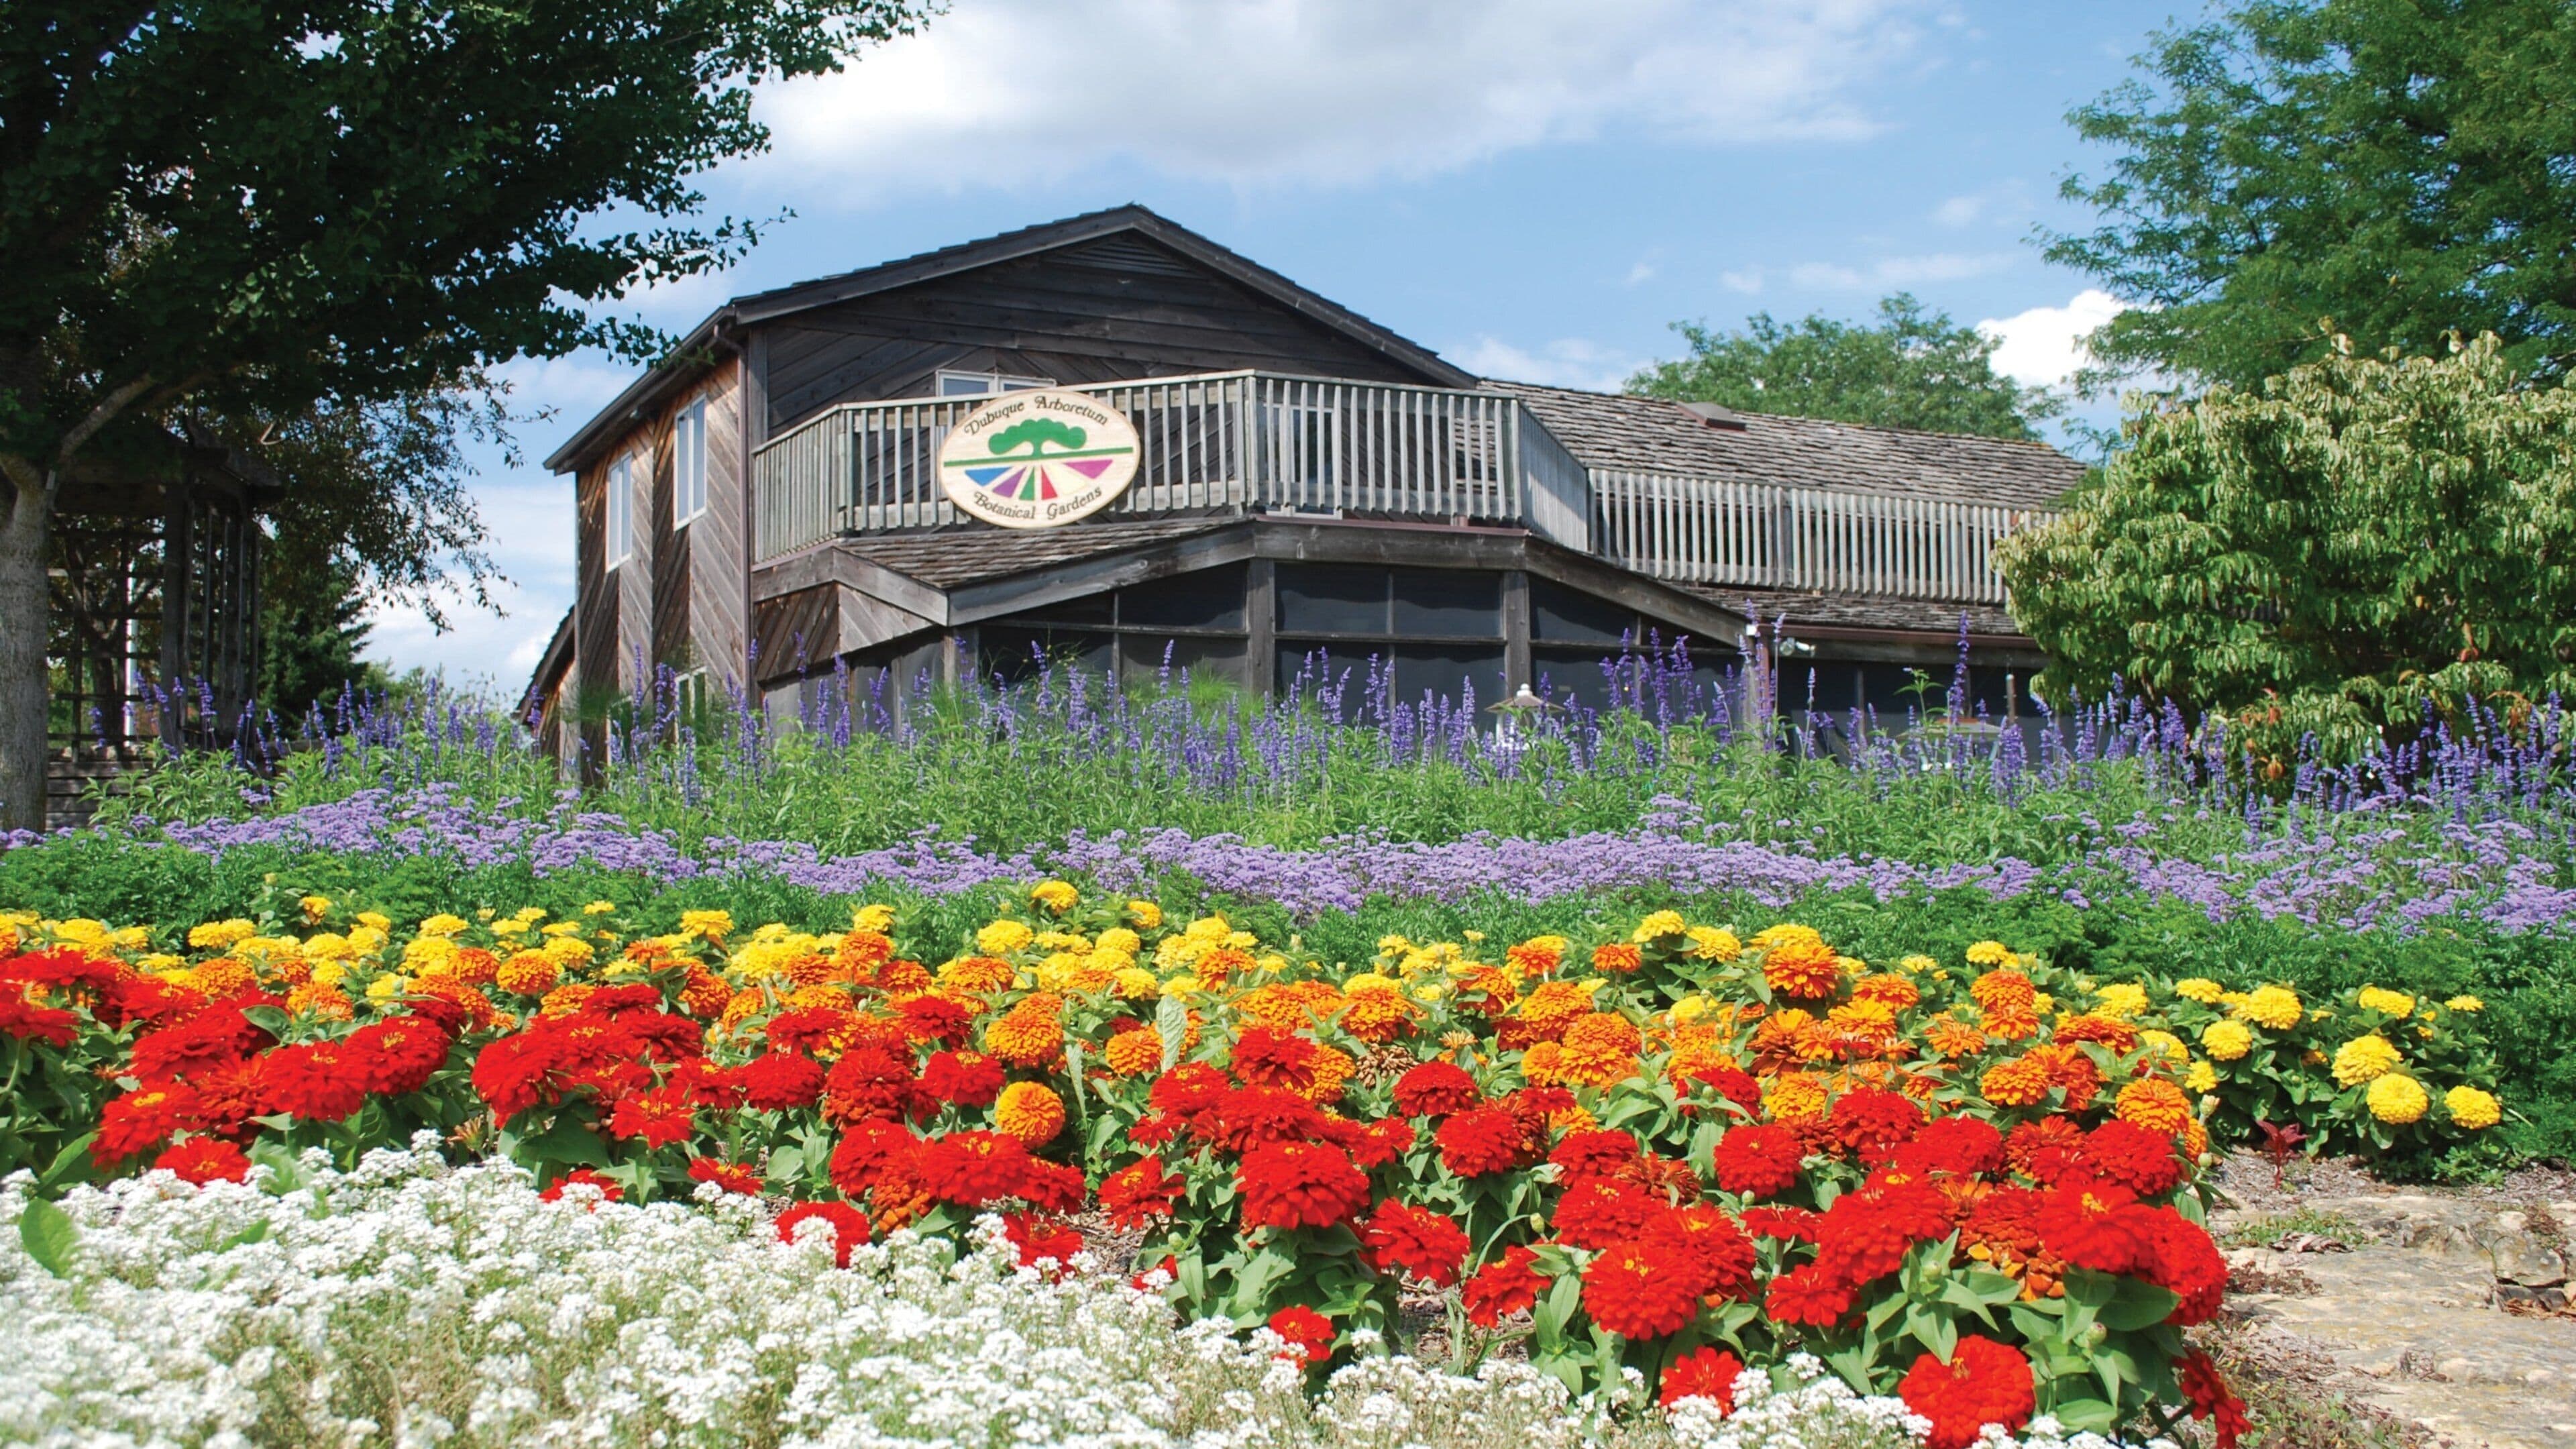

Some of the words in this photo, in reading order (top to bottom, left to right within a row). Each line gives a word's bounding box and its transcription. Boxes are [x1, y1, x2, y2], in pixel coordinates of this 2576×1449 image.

[964, 402, 1025, 435] Dubuque
[1034, 396, 1108, 426] Arboretum
[973, 491, 1035, 519] Botanical
[1046, 486, 1102, 519] Gardens
